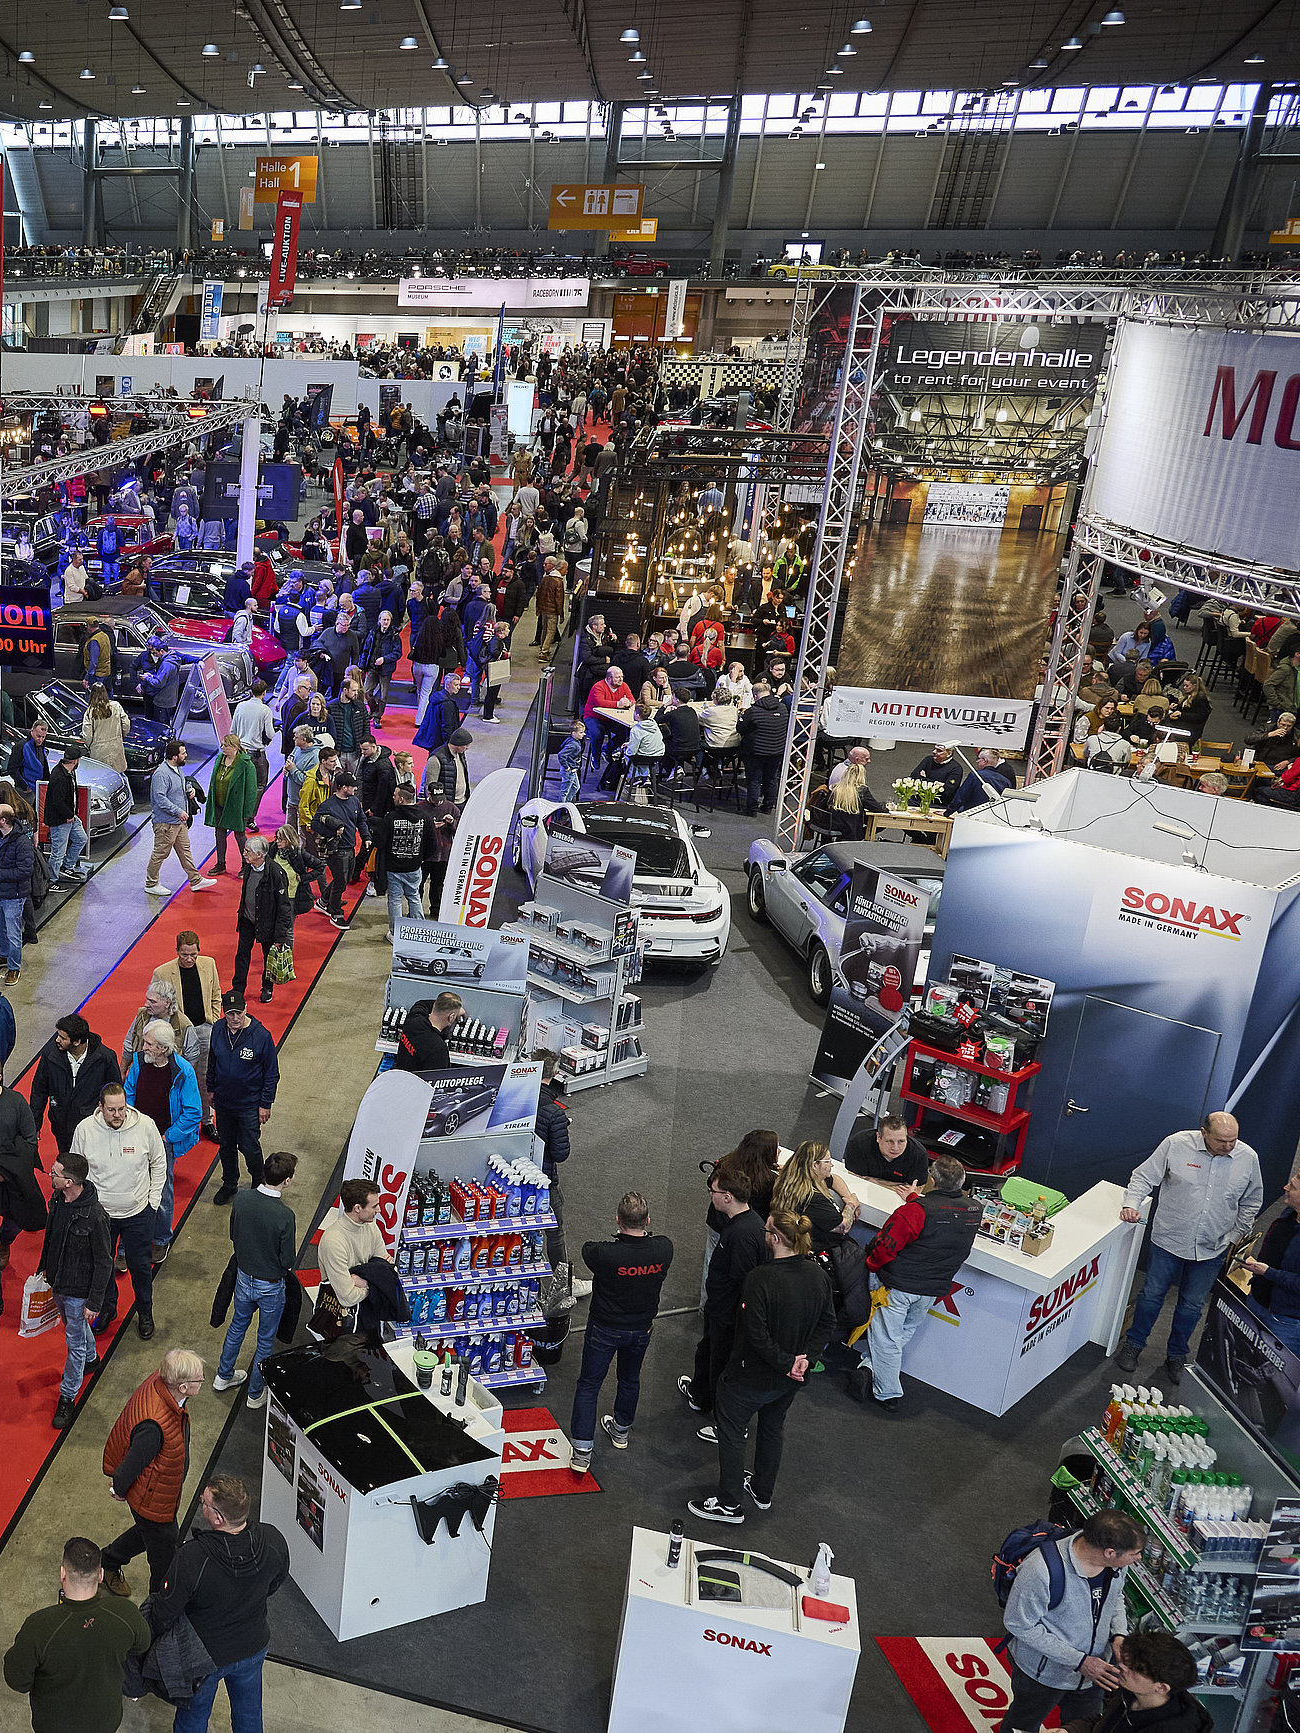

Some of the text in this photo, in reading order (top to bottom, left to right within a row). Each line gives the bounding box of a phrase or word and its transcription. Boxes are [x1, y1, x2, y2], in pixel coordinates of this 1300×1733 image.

[259, 178, 279, 188] Hall
[260, 161, 300, 188] Halle 1
[278, 216, 292, 283] LIVE-AUKTION
[532, 289, 559, 297] RACEBORN
[896, 346, 1093, 369] Legendenhalle
[894, 374, 1089, 389] to rent for your event
[18, 639, 47, 654] Uhr
[870, 702, 1017, 724] MOTORWORLD
[900, 722, 940, 730] STUTTGART
[551, 830, 575, 844] ZUBEHÖR
[453, 834, 475, 906] MADE IN GERMANY
[884, 884, 919, 906] SONAX
[853, 905, 900, 932] FANTASTISCH AN!
[855, 895, 909, 926] FÜHLT SICH EINFACH
[1120, 885, 1246, 937] SONAX
[400, 925, 457, 939] PROFESSIONELLE
[1118, 913, 1199, 940] MADE IN GERMANY
[400, 933, 484, 951] FAHRZEUGAUFWERTUNG
[500, 935, 525, 944] SONAX
[400, 1031, 416, 1056] ONAX
[511, 1066, 538, 1075] SONAX
[434, 1076, 484, 1089] AUTOPFLEGE
[503, 1122, 530, 1130] XTREME
[617, 1263, 663, 1277] SONAX
[1025, 1254, 1101, 1332] SONAX
[1020, 1308, 1072, 1358] MADE IN GERMANY
[1217, 1298, 1286, 1373] INNENRAUM SCHEIBE
[317, 1462, 347, 1504] SONAX
[703, 1628, 773, 1657] SONAX
